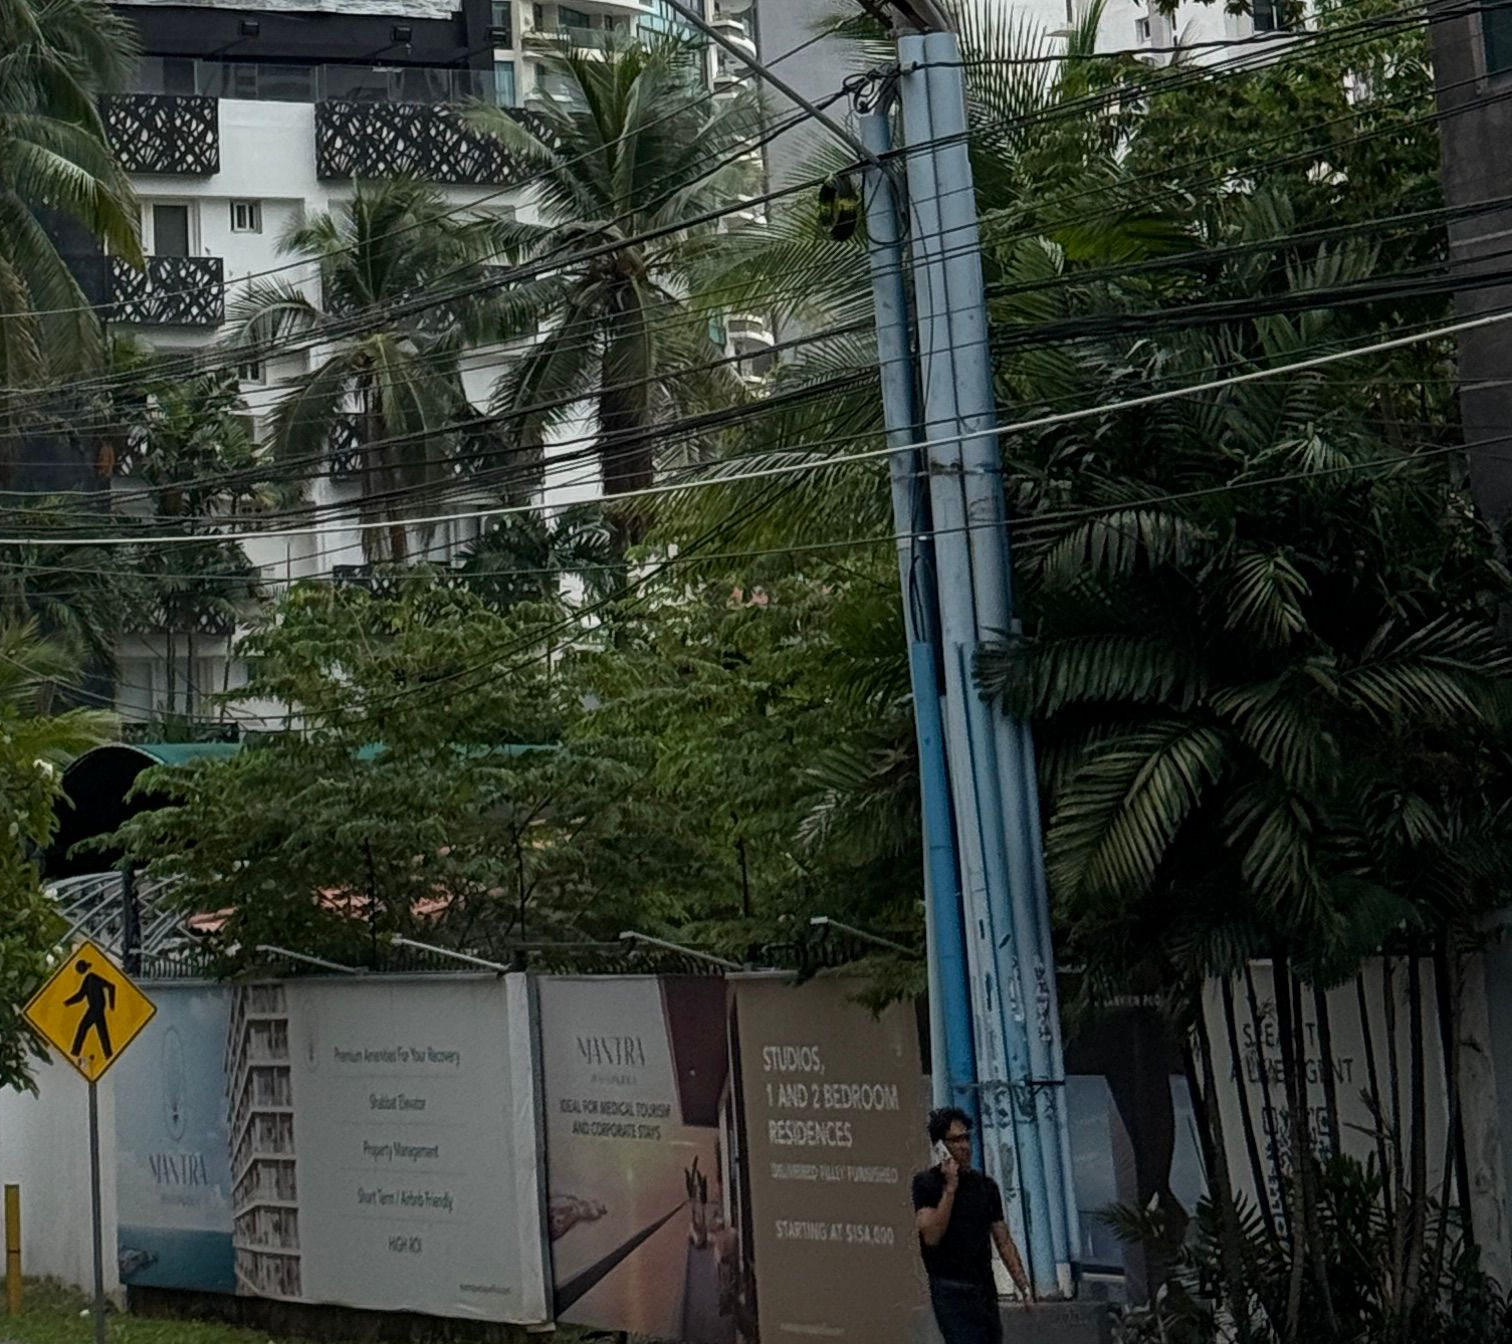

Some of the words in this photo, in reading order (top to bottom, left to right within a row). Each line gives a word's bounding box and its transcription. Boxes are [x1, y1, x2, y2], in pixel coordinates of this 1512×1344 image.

[763, 1045, 826, 1075] STUDIOS,
[766, 1082, 774, 1107] 1
[778, 1083, 808, 1109] AND
[811, 1083, 821, 1109] 2
[823, 1083, 900, 1111] BEDROOM
[768, 1119, 853, 1148] RESIDENCES
[829, 1222, 844, 1242] AT
